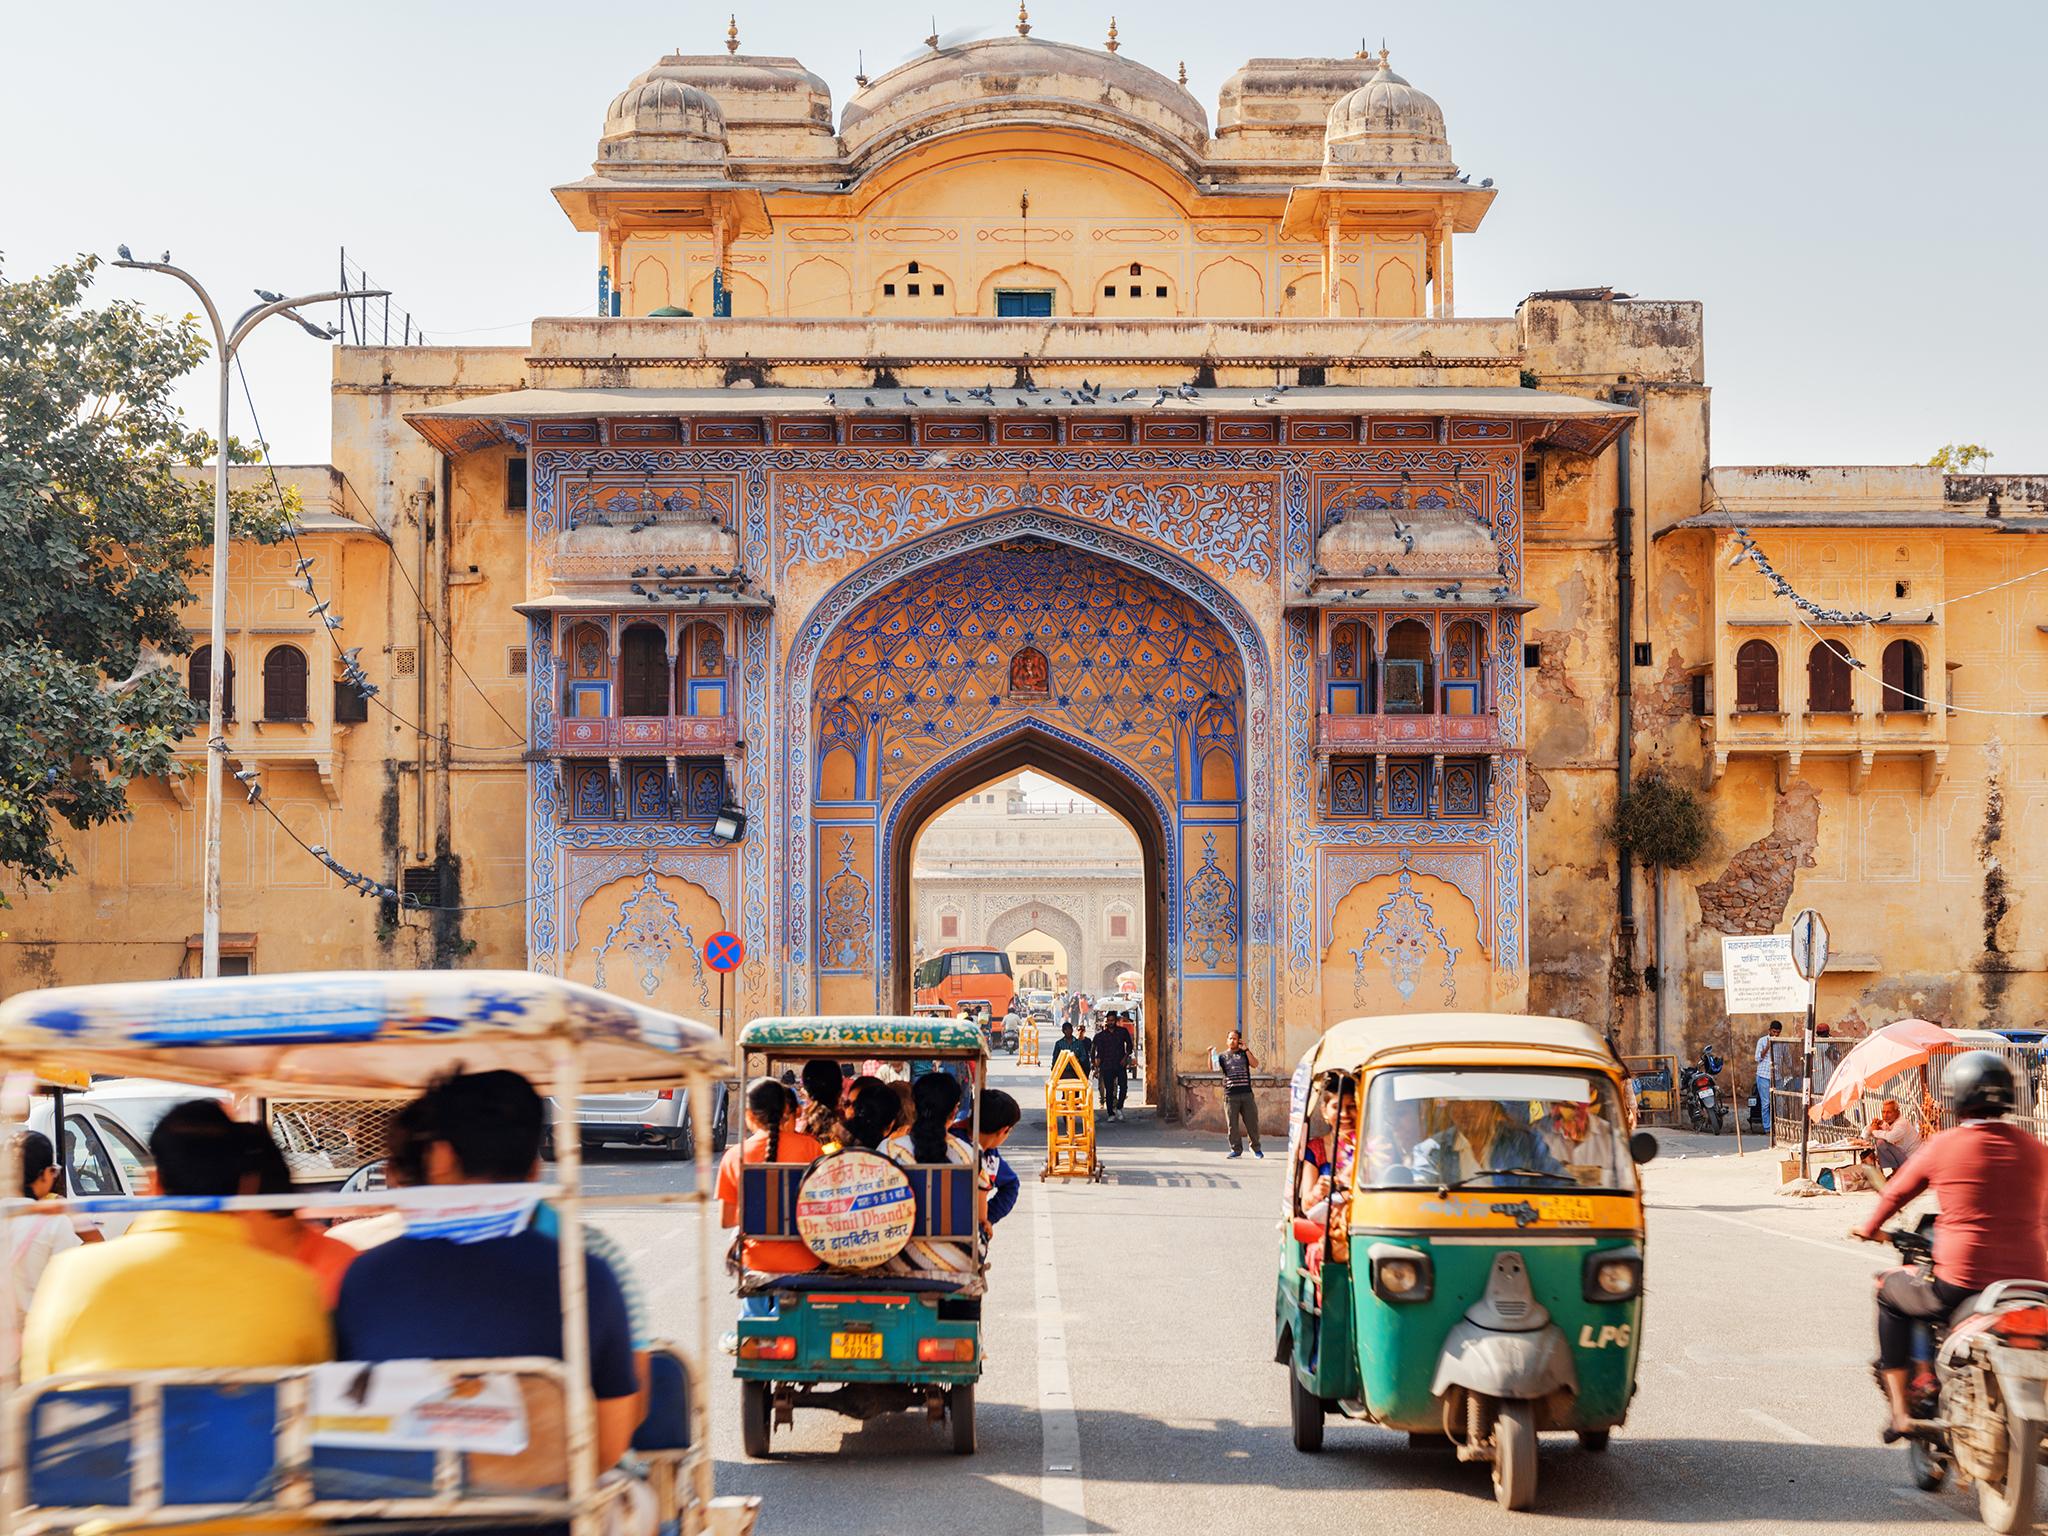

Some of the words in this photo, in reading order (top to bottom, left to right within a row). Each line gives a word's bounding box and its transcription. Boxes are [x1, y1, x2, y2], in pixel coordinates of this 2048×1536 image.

[803, 1219, 823, 1235] Dr.
[825, 1211, 860, 1233] Sunil
[862, 1203, 912, 1228] Dhand's
[1579, 1323, 1630, 1348] LPG
